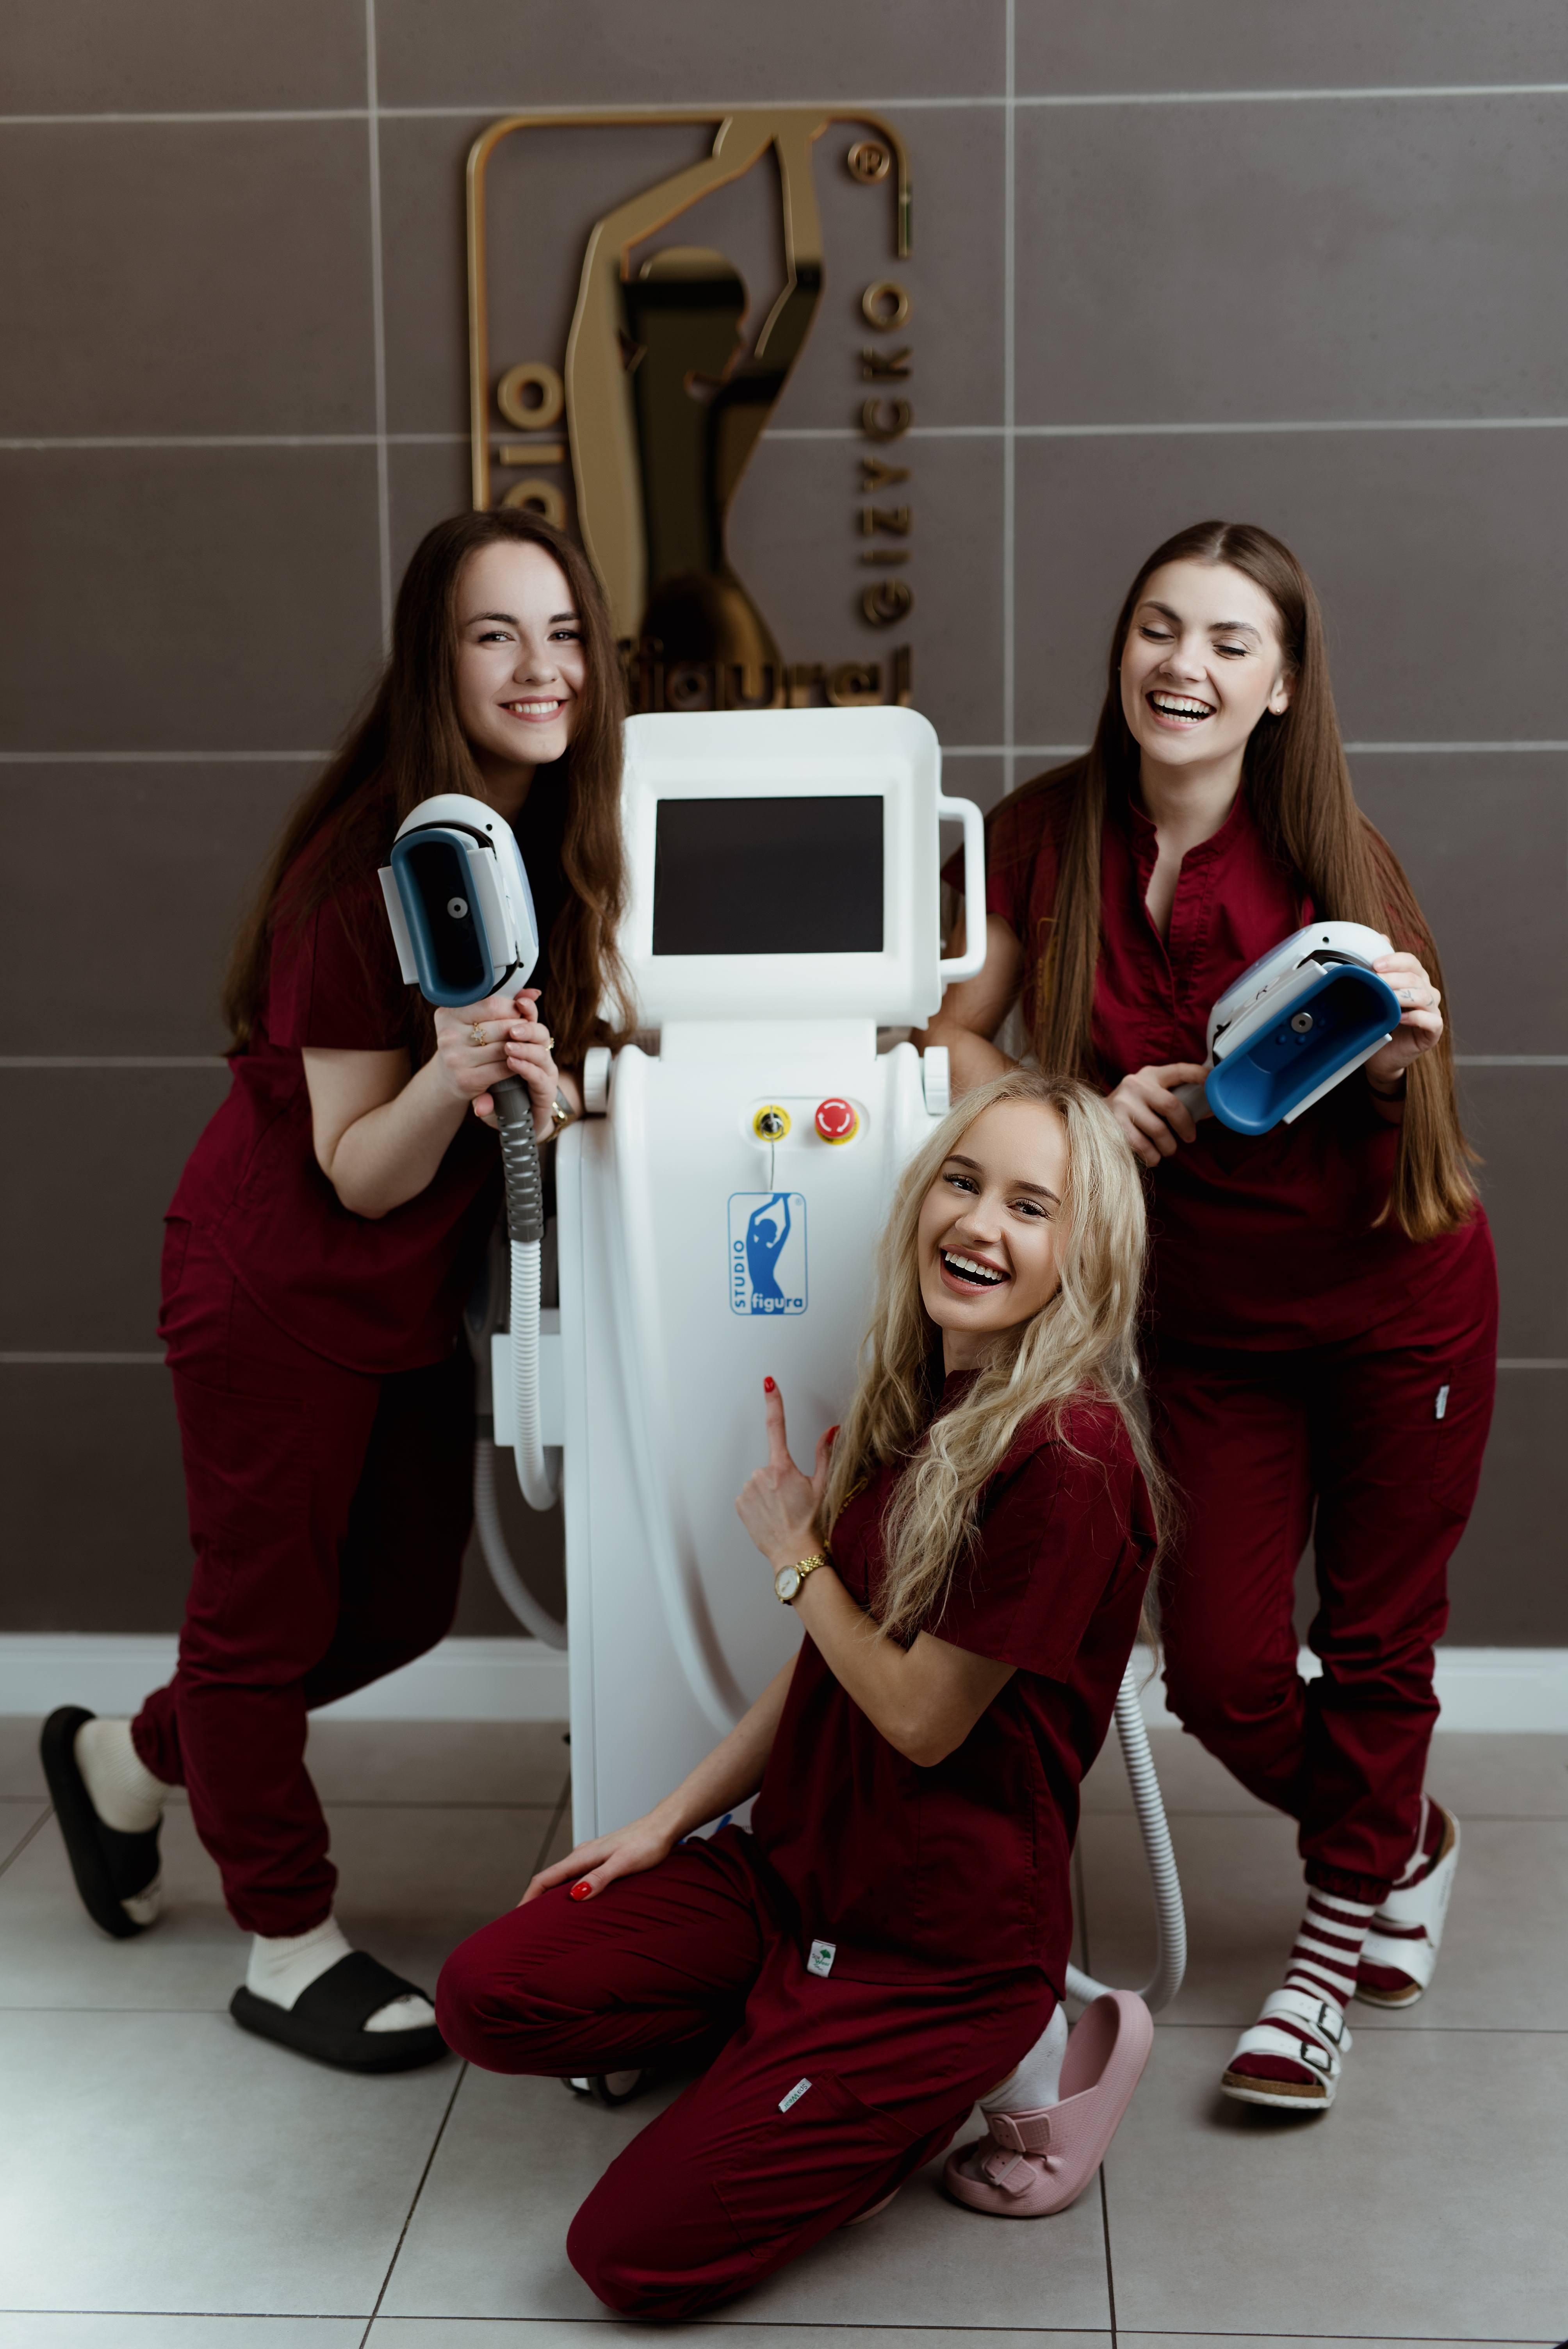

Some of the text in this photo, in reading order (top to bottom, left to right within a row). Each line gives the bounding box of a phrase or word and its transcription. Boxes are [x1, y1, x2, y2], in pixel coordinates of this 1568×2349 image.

[497, 362, 565, 531] DIO
[734, 1240, 745, 1308] STUDIO
[752, 1292, 803, 1313] figura
[784, 2084, 807, 2109] Spa Wear
